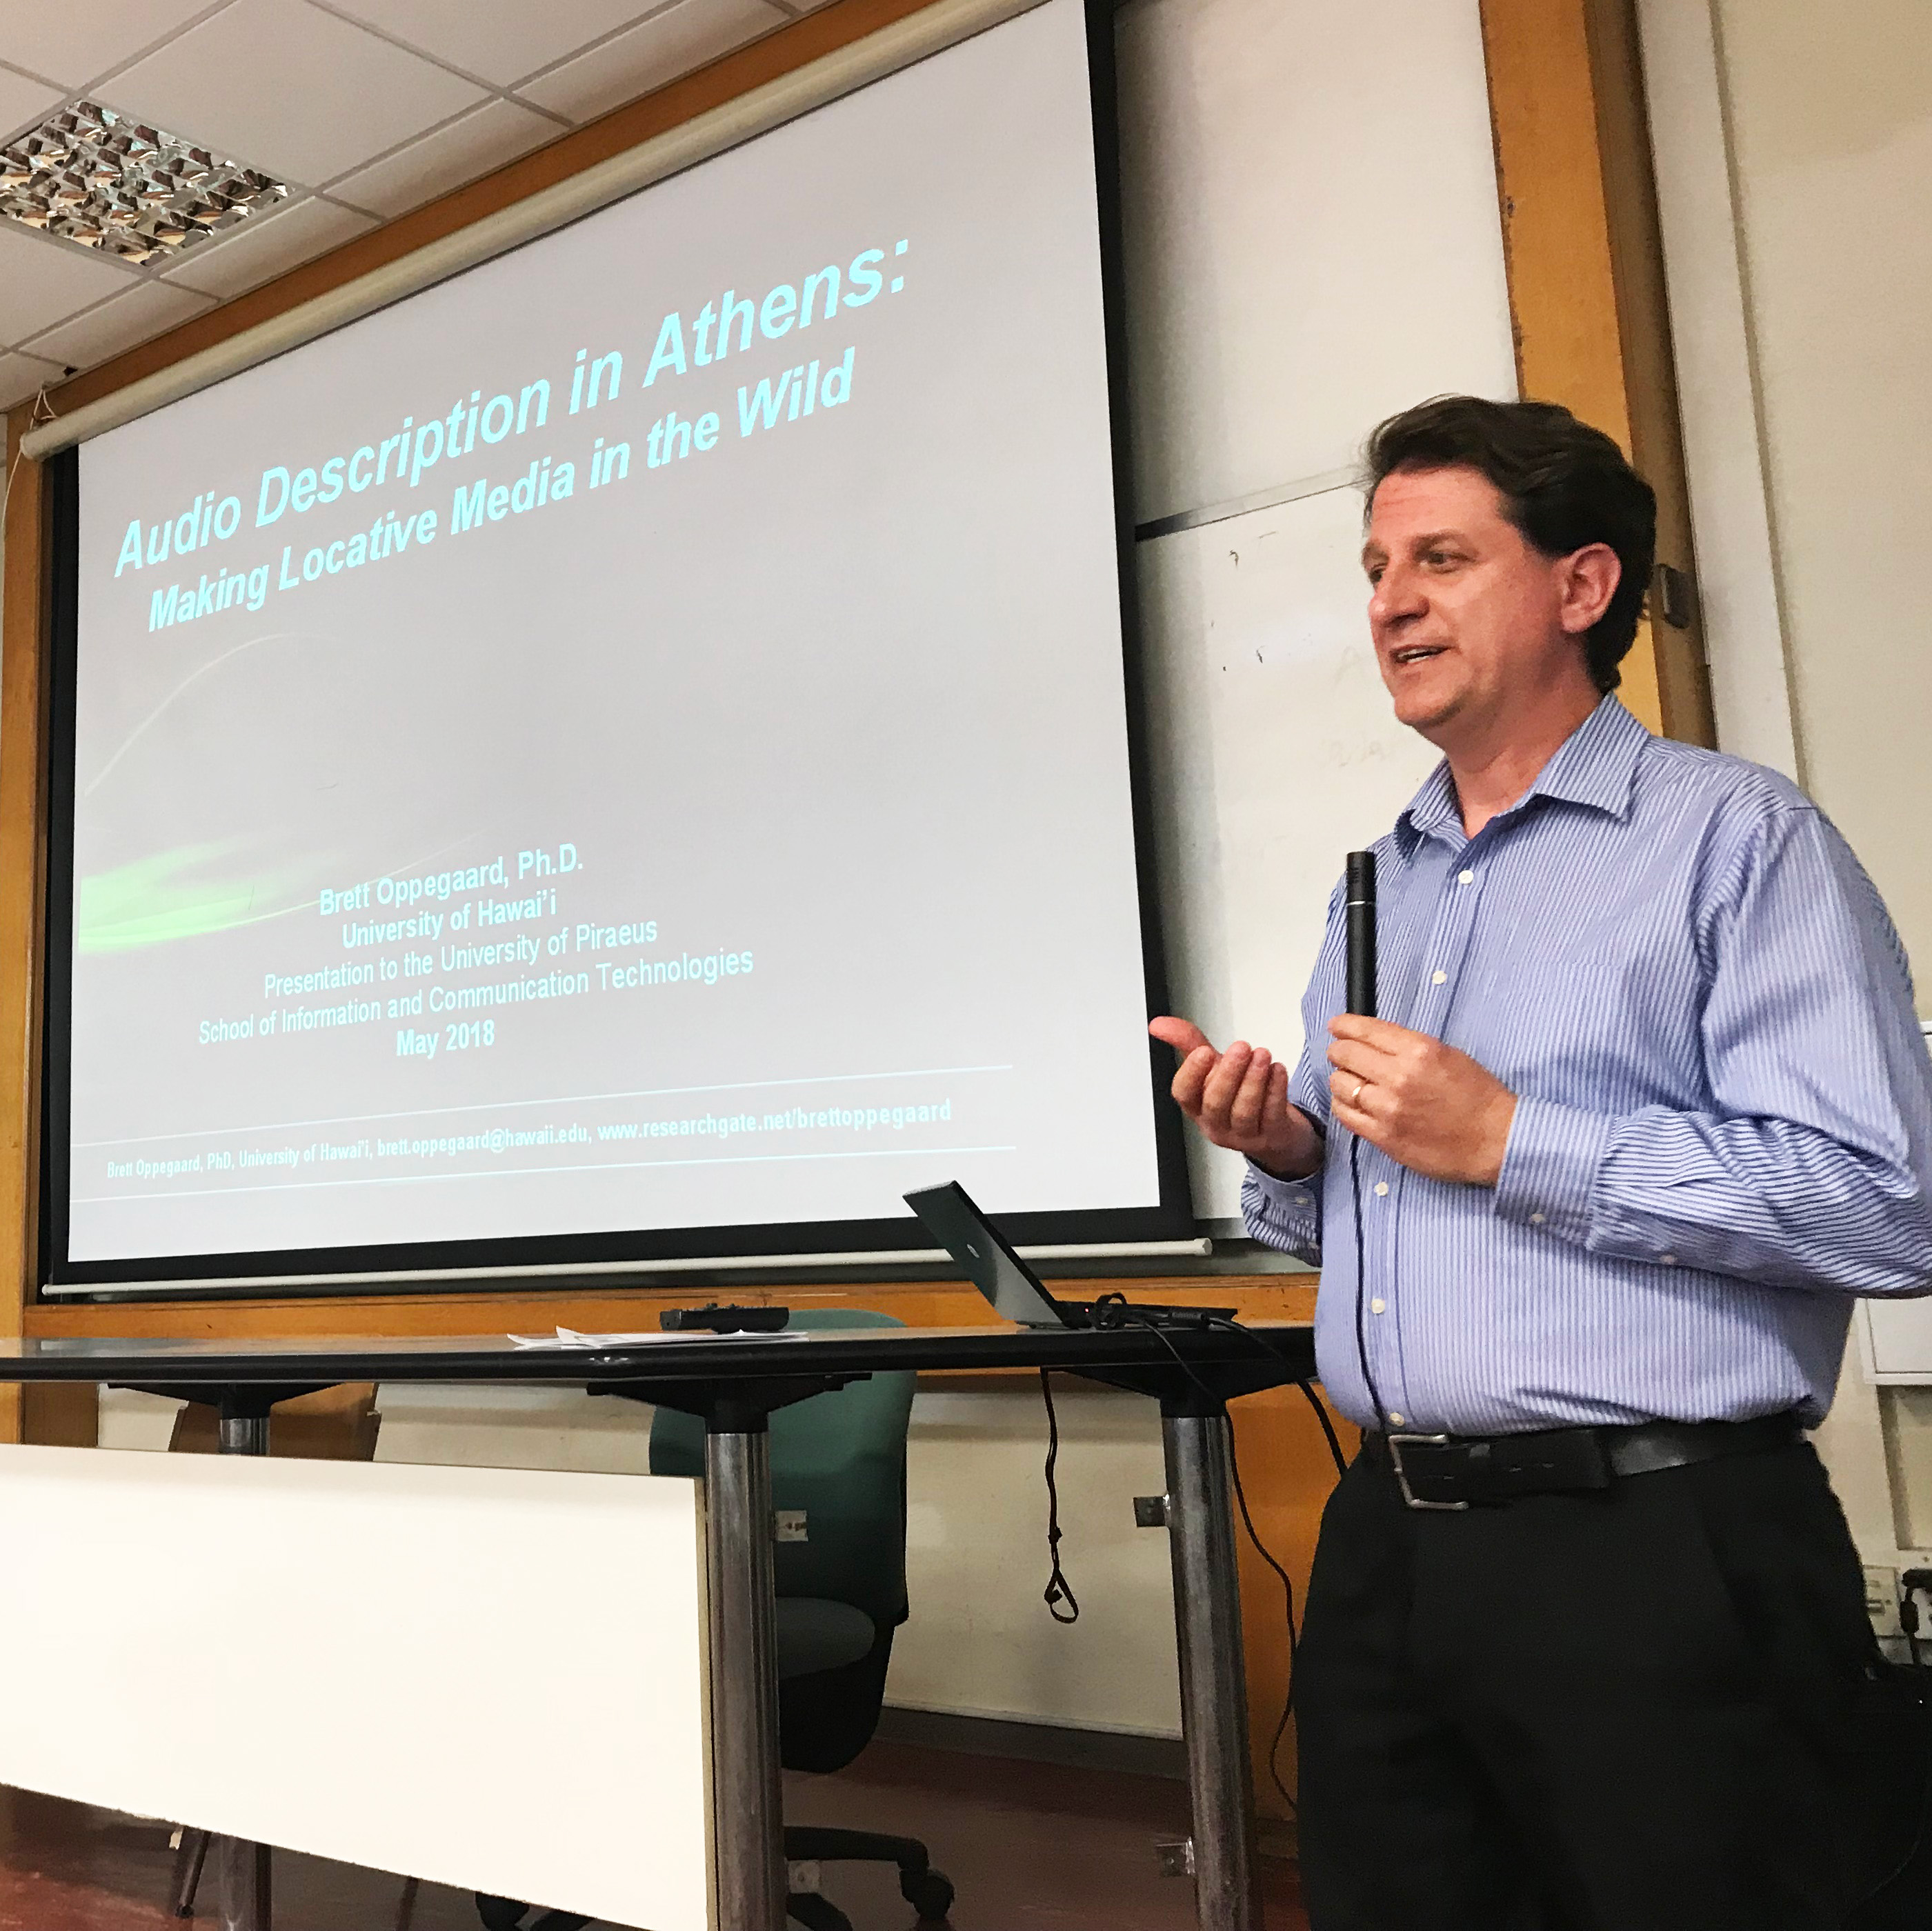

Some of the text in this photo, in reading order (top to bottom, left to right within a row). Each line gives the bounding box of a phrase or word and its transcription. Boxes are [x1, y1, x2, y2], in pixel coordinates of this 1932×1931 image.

[114, 239, 908, 577] Audio Description in Athens:
[149, 346, 855, 632] Making Locative Media in the Wild
[319, 843, 584, 915] Brett Oppegaard, Ph.D.
[264, 920, 657, 998] Presentation to the University of Piraeus
[342, 911, 444, 948] University
[450, 902, 470, 931] of
[199, 948, 754, 1044] School of Information and Communication Technologies
[396, 1019, 495, 1059] May 2018
[107, 1160, 134, 1178] Brett
[136, 1154, 203, 1179] Oppegaard,
[207, 1150, 235, 1171] PhD,
[239, 1145, 299, 1168] University
[303, 1143, 317, 1163] of
[377, 1124, 592, 1158] brett.oppegaard@hawaii.edu,
[597, 1099, 952, 1141] www.researchgate.net/brettoppegaard
